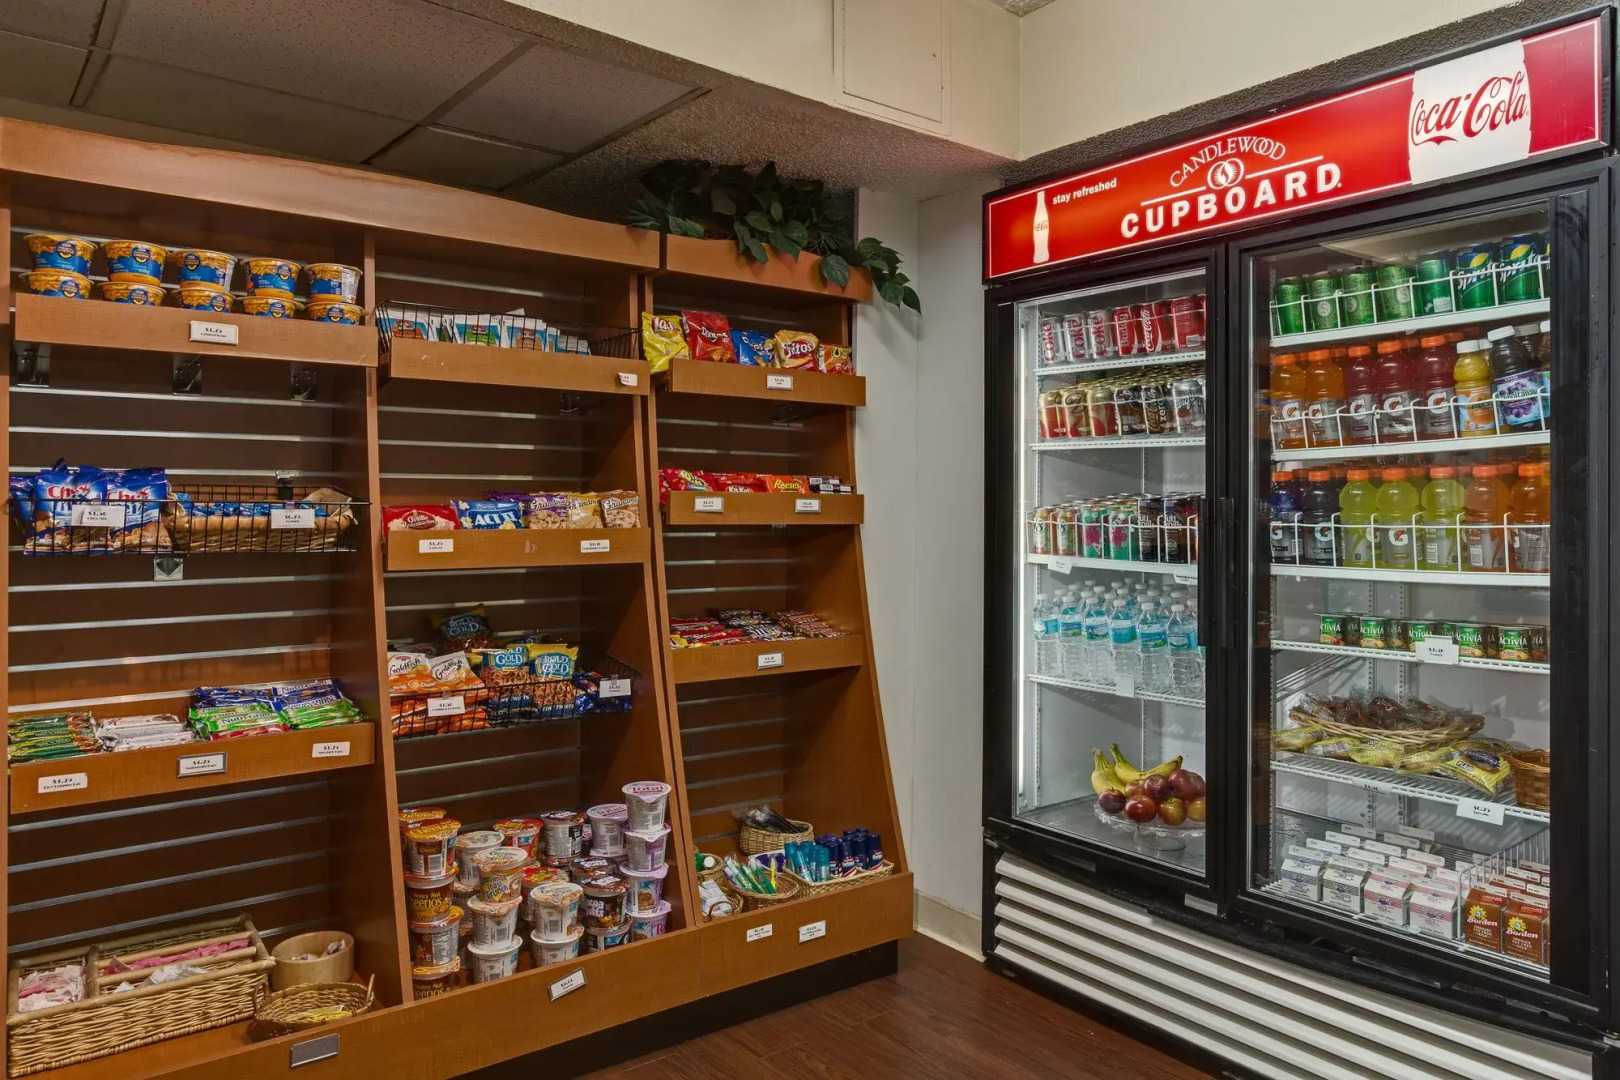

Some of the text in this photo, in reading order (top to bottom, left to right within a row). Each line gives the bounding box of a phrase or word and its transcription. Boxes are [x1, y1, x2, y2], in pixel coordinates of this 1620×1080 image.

[1411, 71, 1527, 146] Coca-Cola
[1170, 136, 1286, 187] CANDLEWOOD
[1053, 178, 1117, 205] stay refreshed
[783, 341, 813, 358] Fritos
[774, 479, 800, 489] Reese's
[475, 511, 518, 526] ACT II
[389, 657, 421, 675] Goldfish
[1467, 915, 1498, 927] Borden
[1506, 927, 1539, 939] Borden
